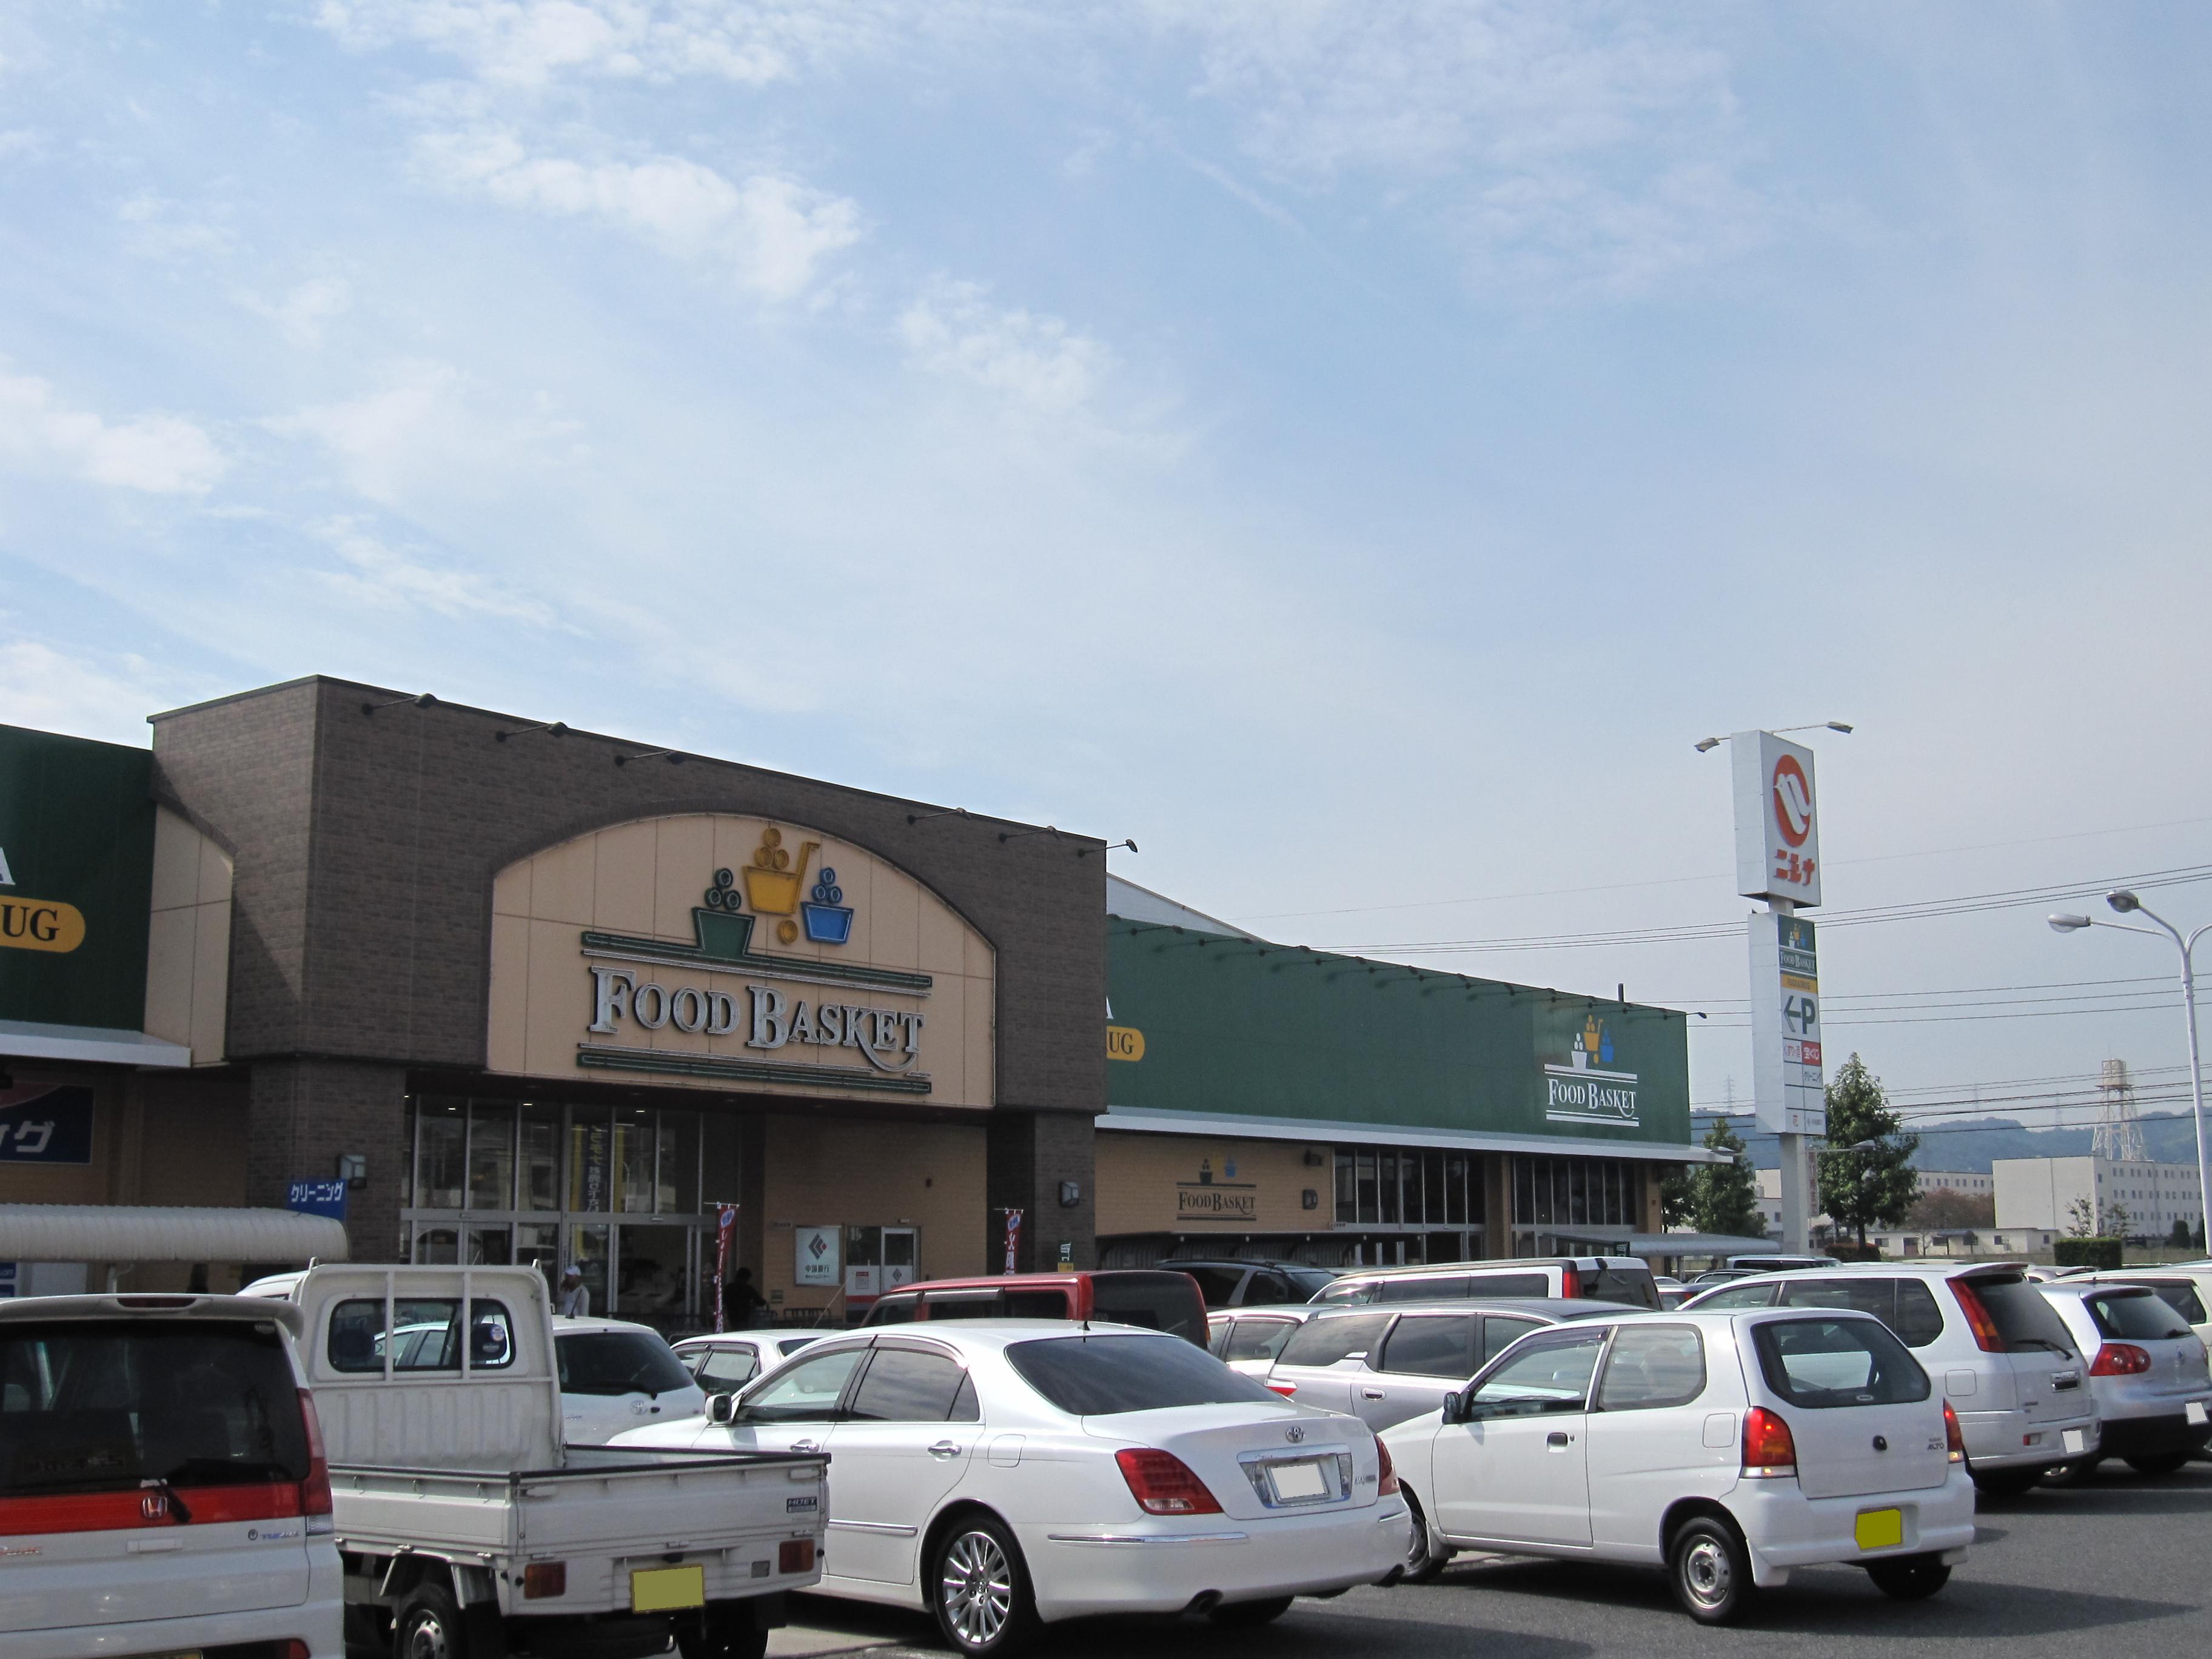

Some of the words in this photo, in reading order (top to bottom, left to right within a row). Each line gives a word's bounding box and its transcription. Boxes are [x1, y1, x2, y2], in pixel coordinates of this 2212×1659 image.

[1780, 951, 1795, 965] FOOD
[1795, 955, 1815, 971] BASKET
[590, 965, 741, 1034] FOOD
[746, 985, 925, 1072] BASKET
[1801, 997, 1815, 1034] P
[1547, 1078, 1586, 1105] FOOD
[1587, 1082, 1637, 1118] BASKET
[291, 1182, 344, 1202] クリーニング
[1178, 1191, 1212, 1210] FOOD
[1213, 1193, 1255, 1215] BASKET
